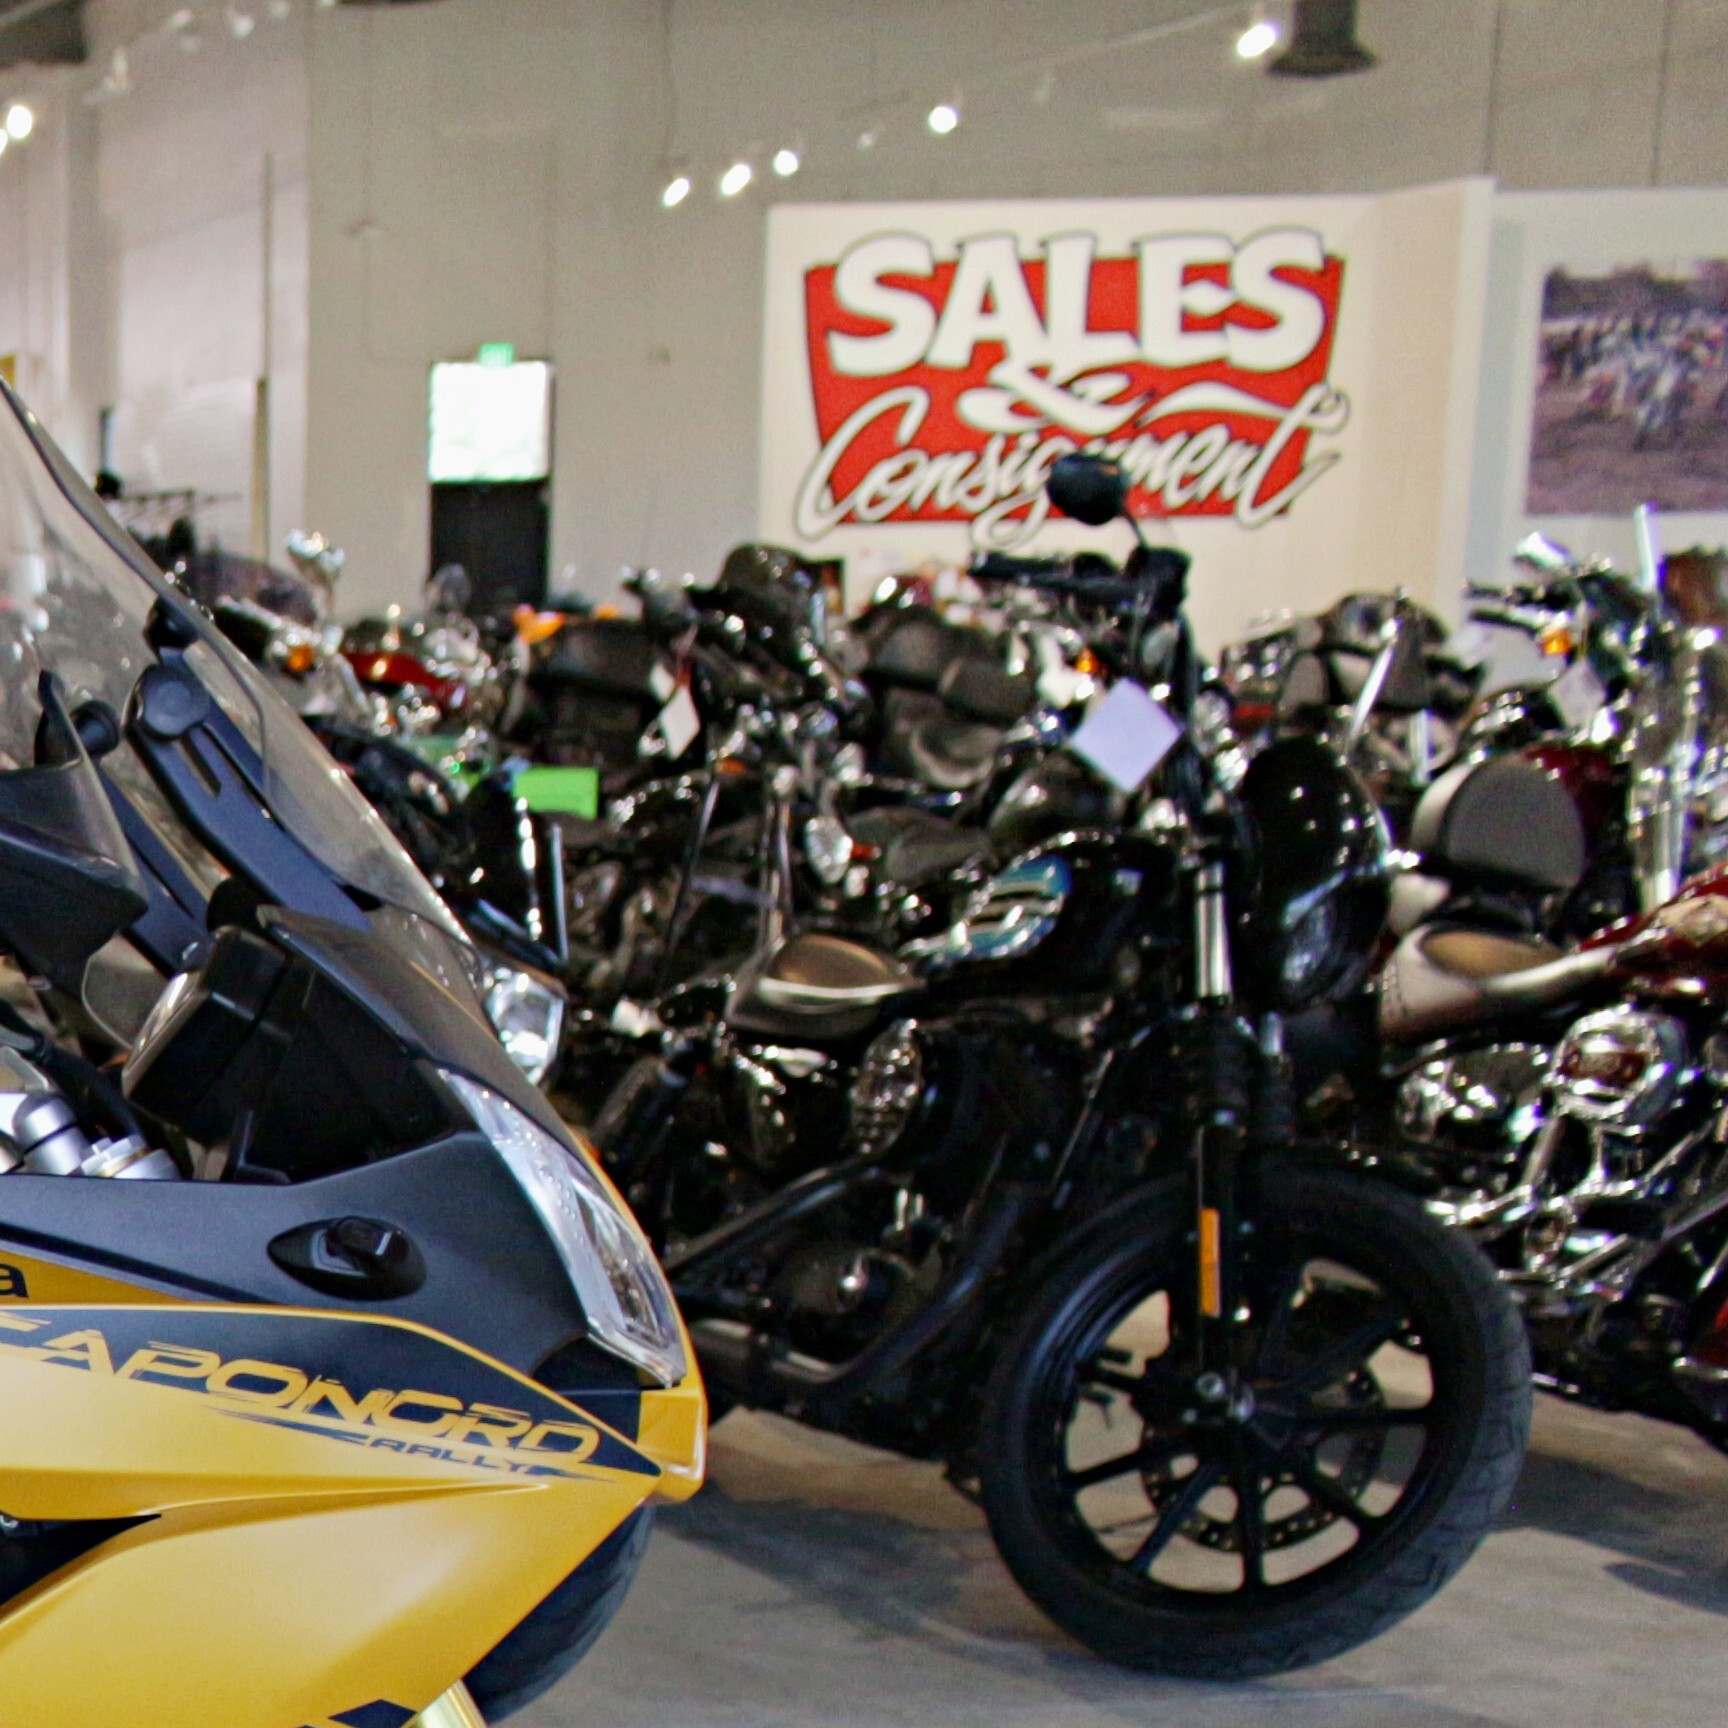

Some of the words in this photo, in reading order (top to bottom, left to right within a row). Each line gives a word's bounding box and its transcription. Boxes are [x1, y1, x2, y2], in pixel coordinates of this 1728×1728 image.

[826, 226, 1327, 378] SALES
[794, 382, 1350, 548] Consigment
[369, 1437, 532, 1474] RALLY
